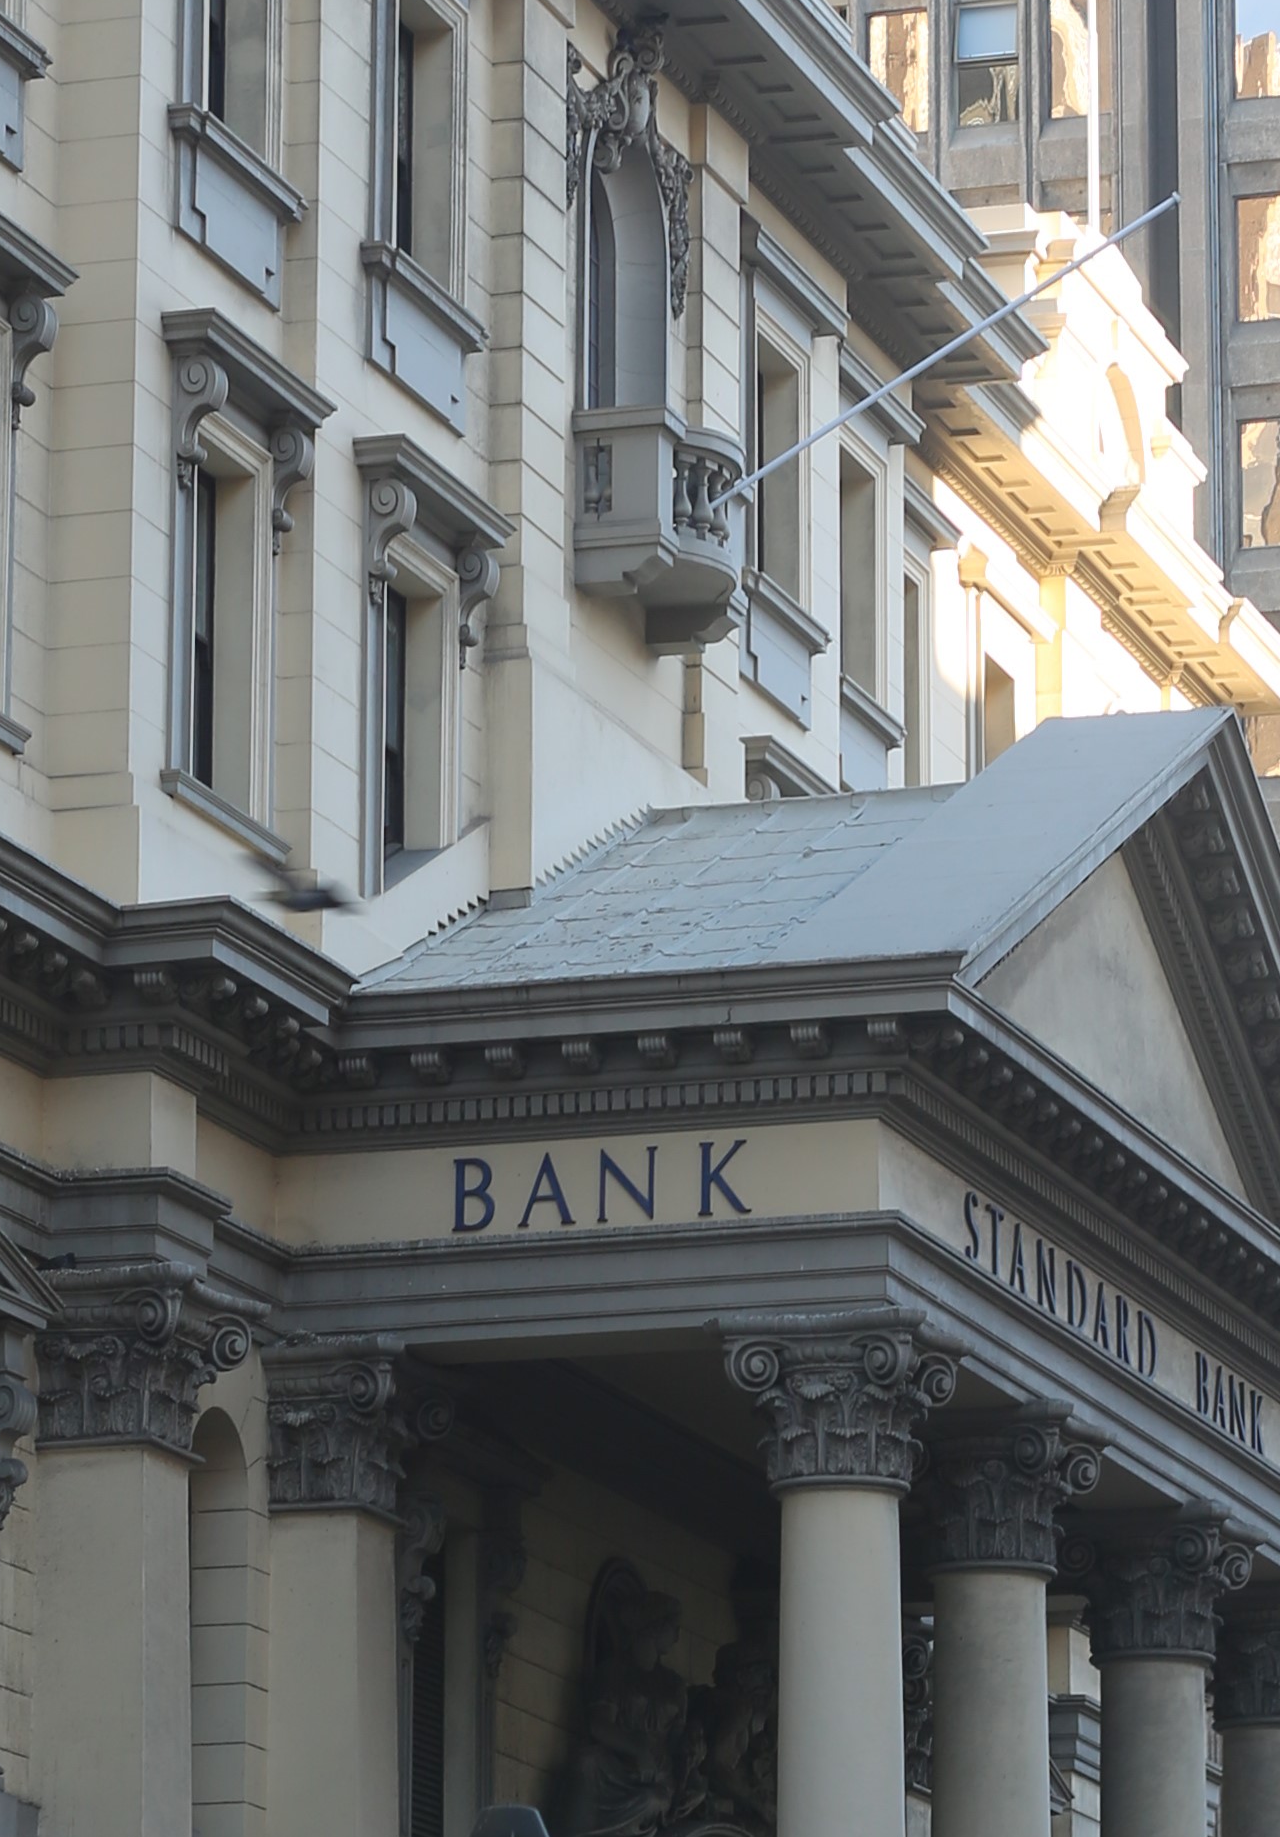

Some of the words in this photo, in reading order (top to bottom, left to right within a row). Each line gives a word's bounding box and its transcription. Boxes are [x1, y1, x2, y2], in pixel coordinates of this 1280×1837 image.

[452, 1139, 752, 1232] BANK
[963, 1190, 1157, 1382] STANDARD
[1194, 1350, 1265, 1456] BANK
